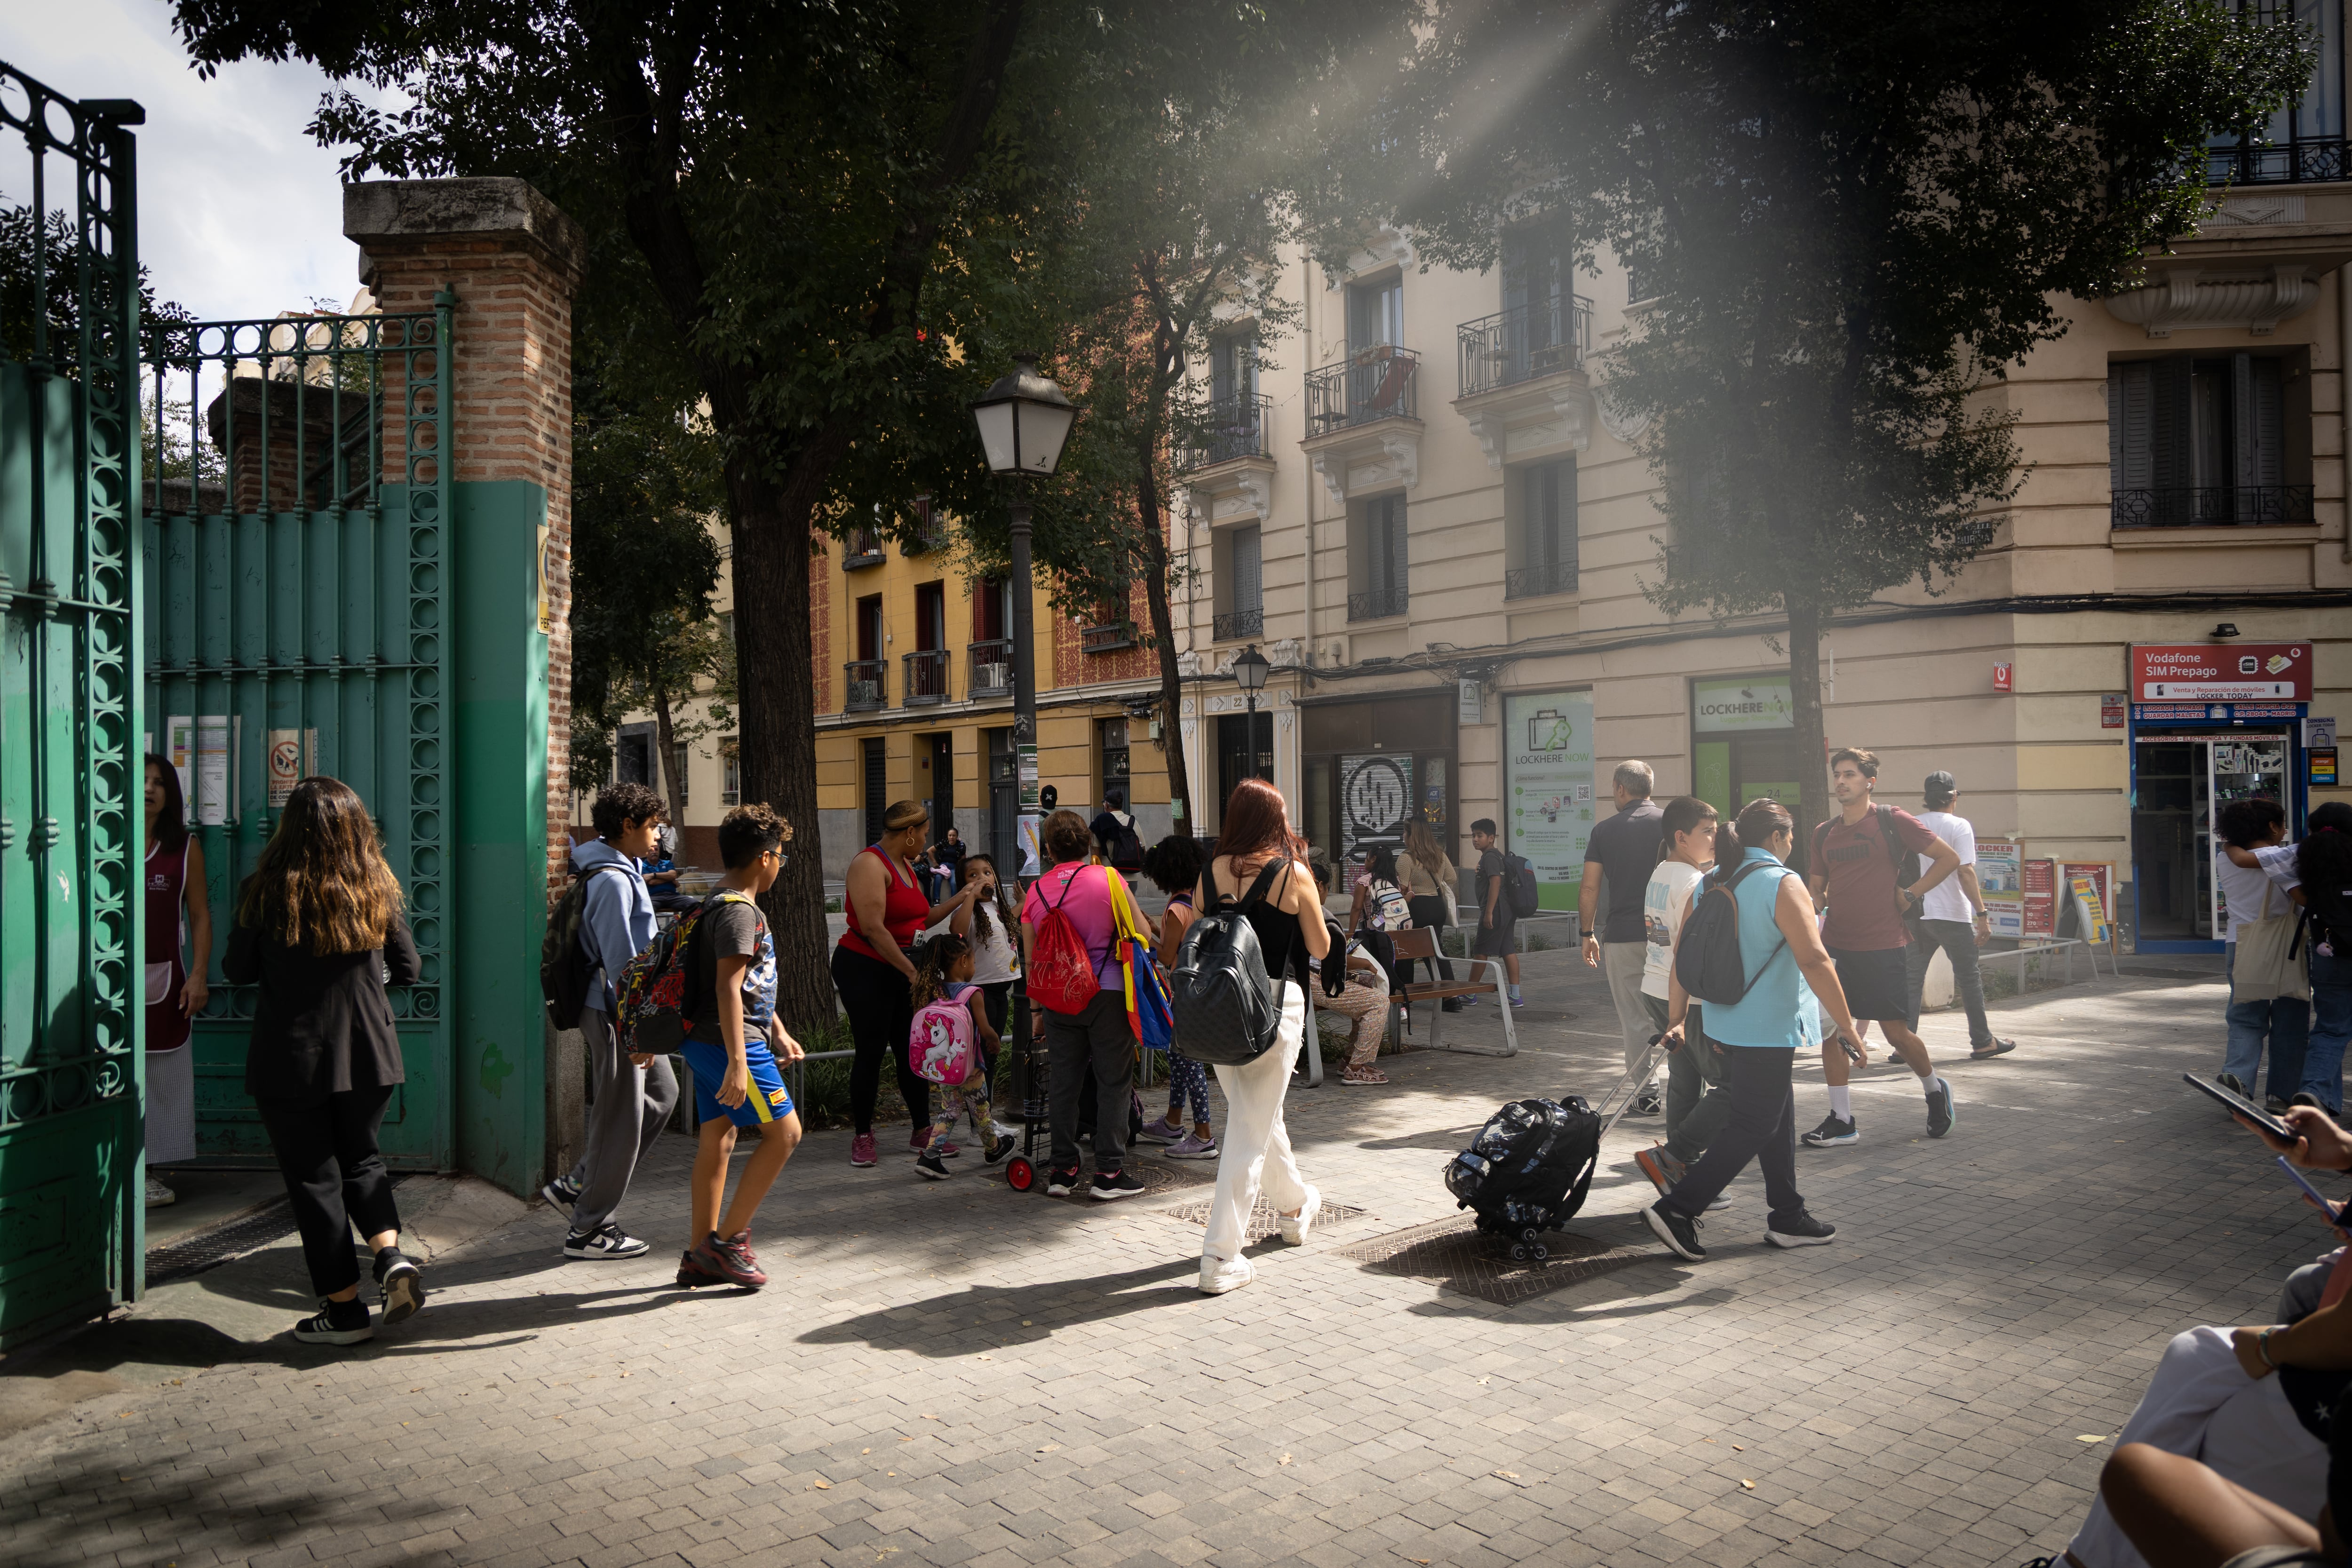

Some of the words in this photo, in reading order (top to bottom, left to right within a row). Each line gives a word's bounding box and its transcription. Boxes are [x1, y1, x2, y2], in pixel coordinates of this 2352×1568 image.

[2145, 653, 2201, 663] Vodafone
[2145, 667, 2167, 676] SIM
[2170, 667, 2217, 678] Prepago
[1234, 697, 1242, 707] 22
[1516, 754, 1563, 764] LOCKHERE
[1565, 753, 1589, 762] NOW
[1766, 789, 1780, 798] 24
[1827, 844, 1869, 863] PUMA
